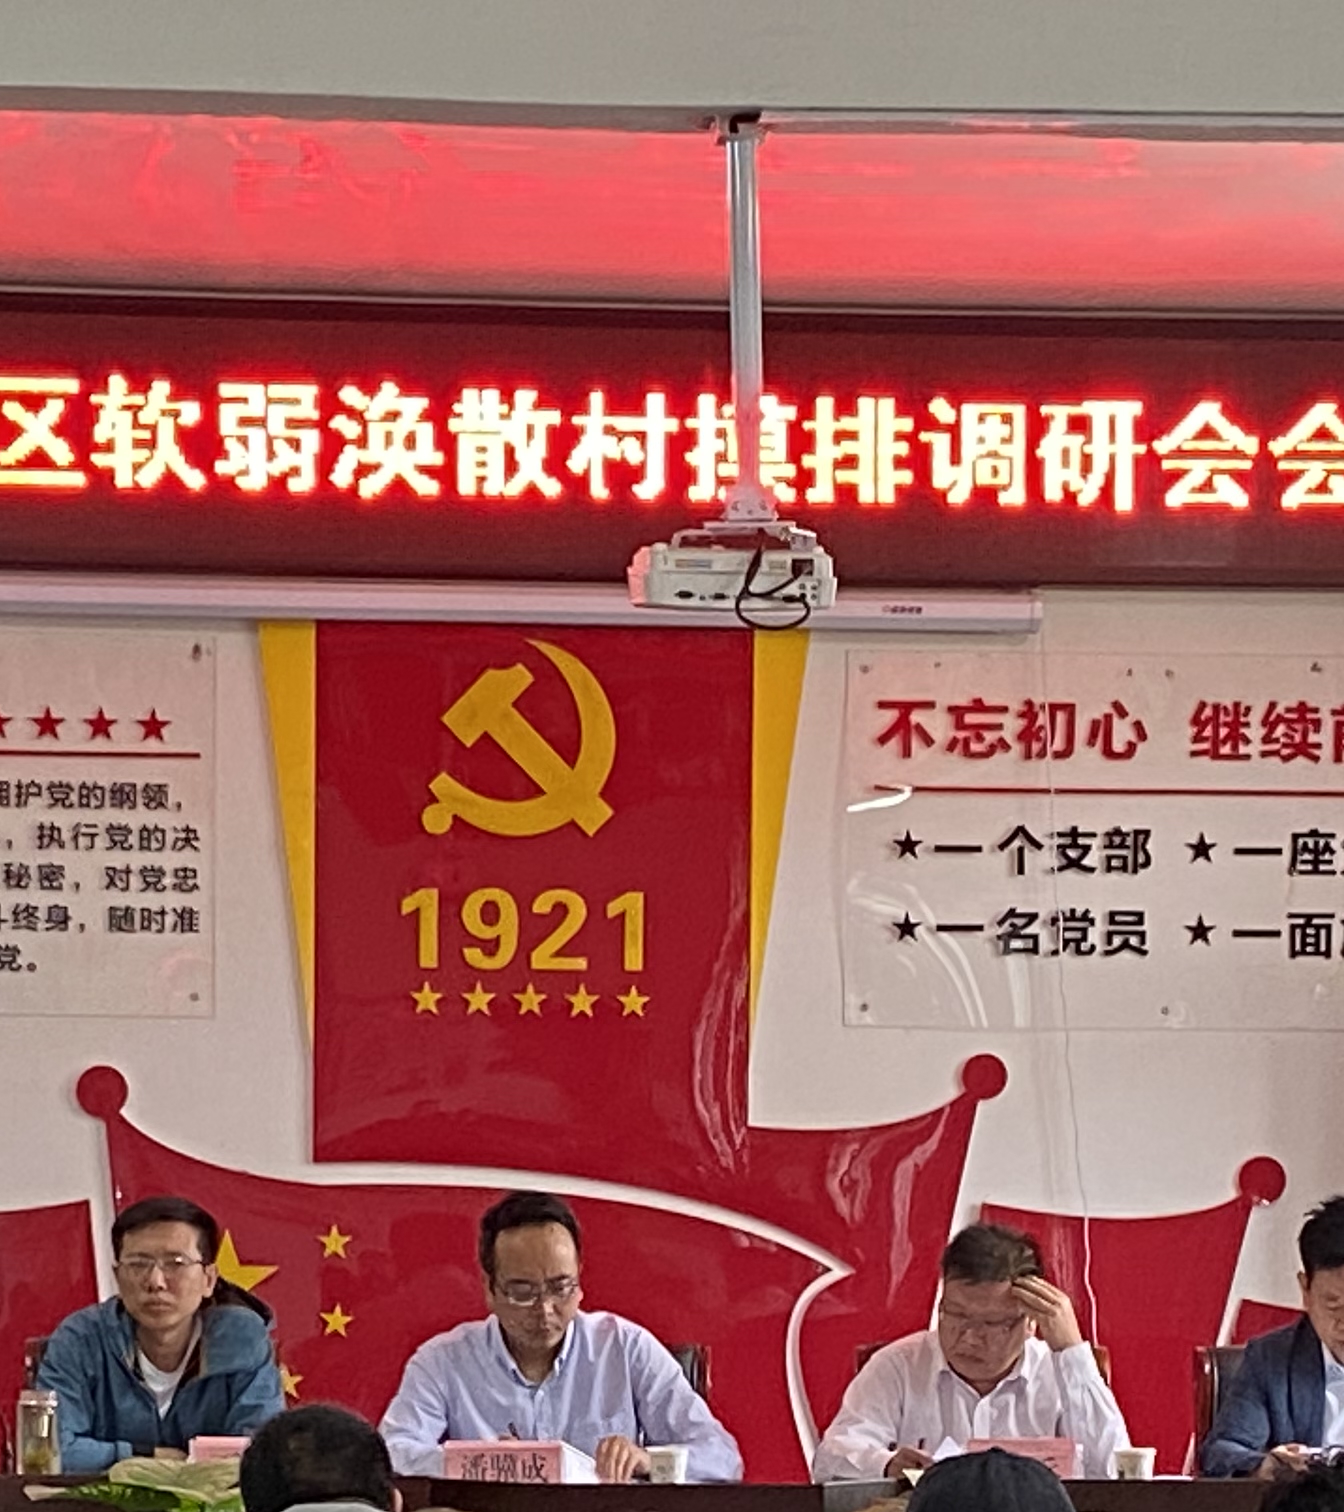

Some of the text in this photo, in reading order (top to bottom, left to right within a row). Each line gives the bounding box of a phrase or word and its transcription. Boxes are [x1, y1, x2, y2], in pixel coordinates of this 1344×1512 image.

[875, 698, 1148, 761] 不忘初心
[934, 825, 1151, 876] 一个支部
[400, 887, 644, 971] 1921
[934, 907, 1149, 957] 一名党员
